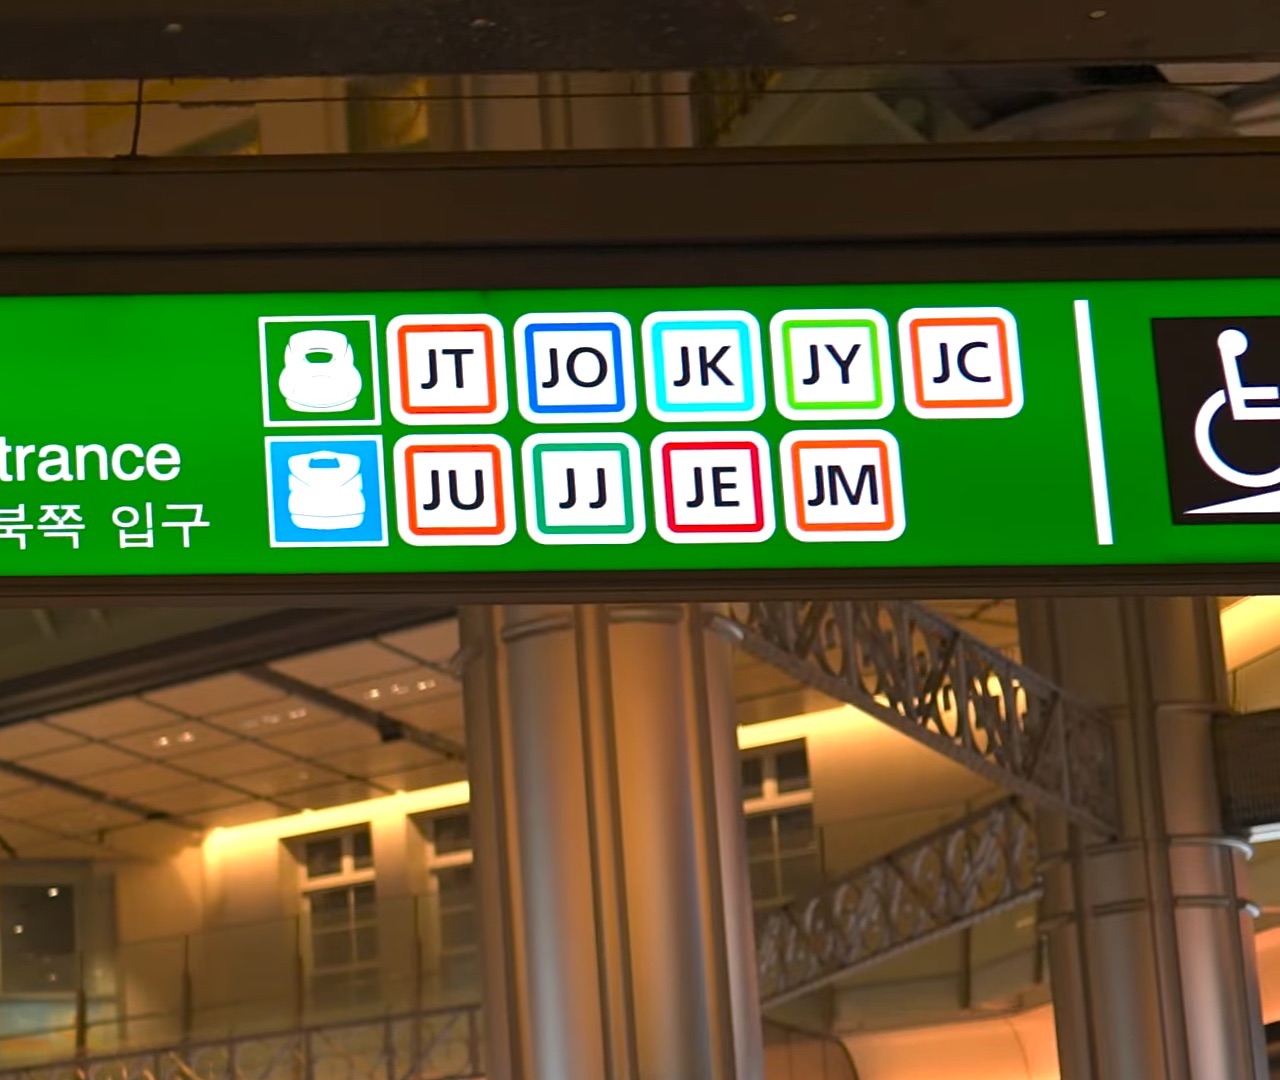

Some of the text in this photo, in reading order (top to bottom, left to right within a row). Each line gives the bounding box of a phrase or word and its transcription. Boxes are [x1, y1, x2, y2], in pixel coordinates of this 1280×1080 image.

[420, 341, 991, 390] JT JO JK JY JC
[423, 464, 879, 511] JU JJ JE JM
[111, 501, 210, 549] 입구
